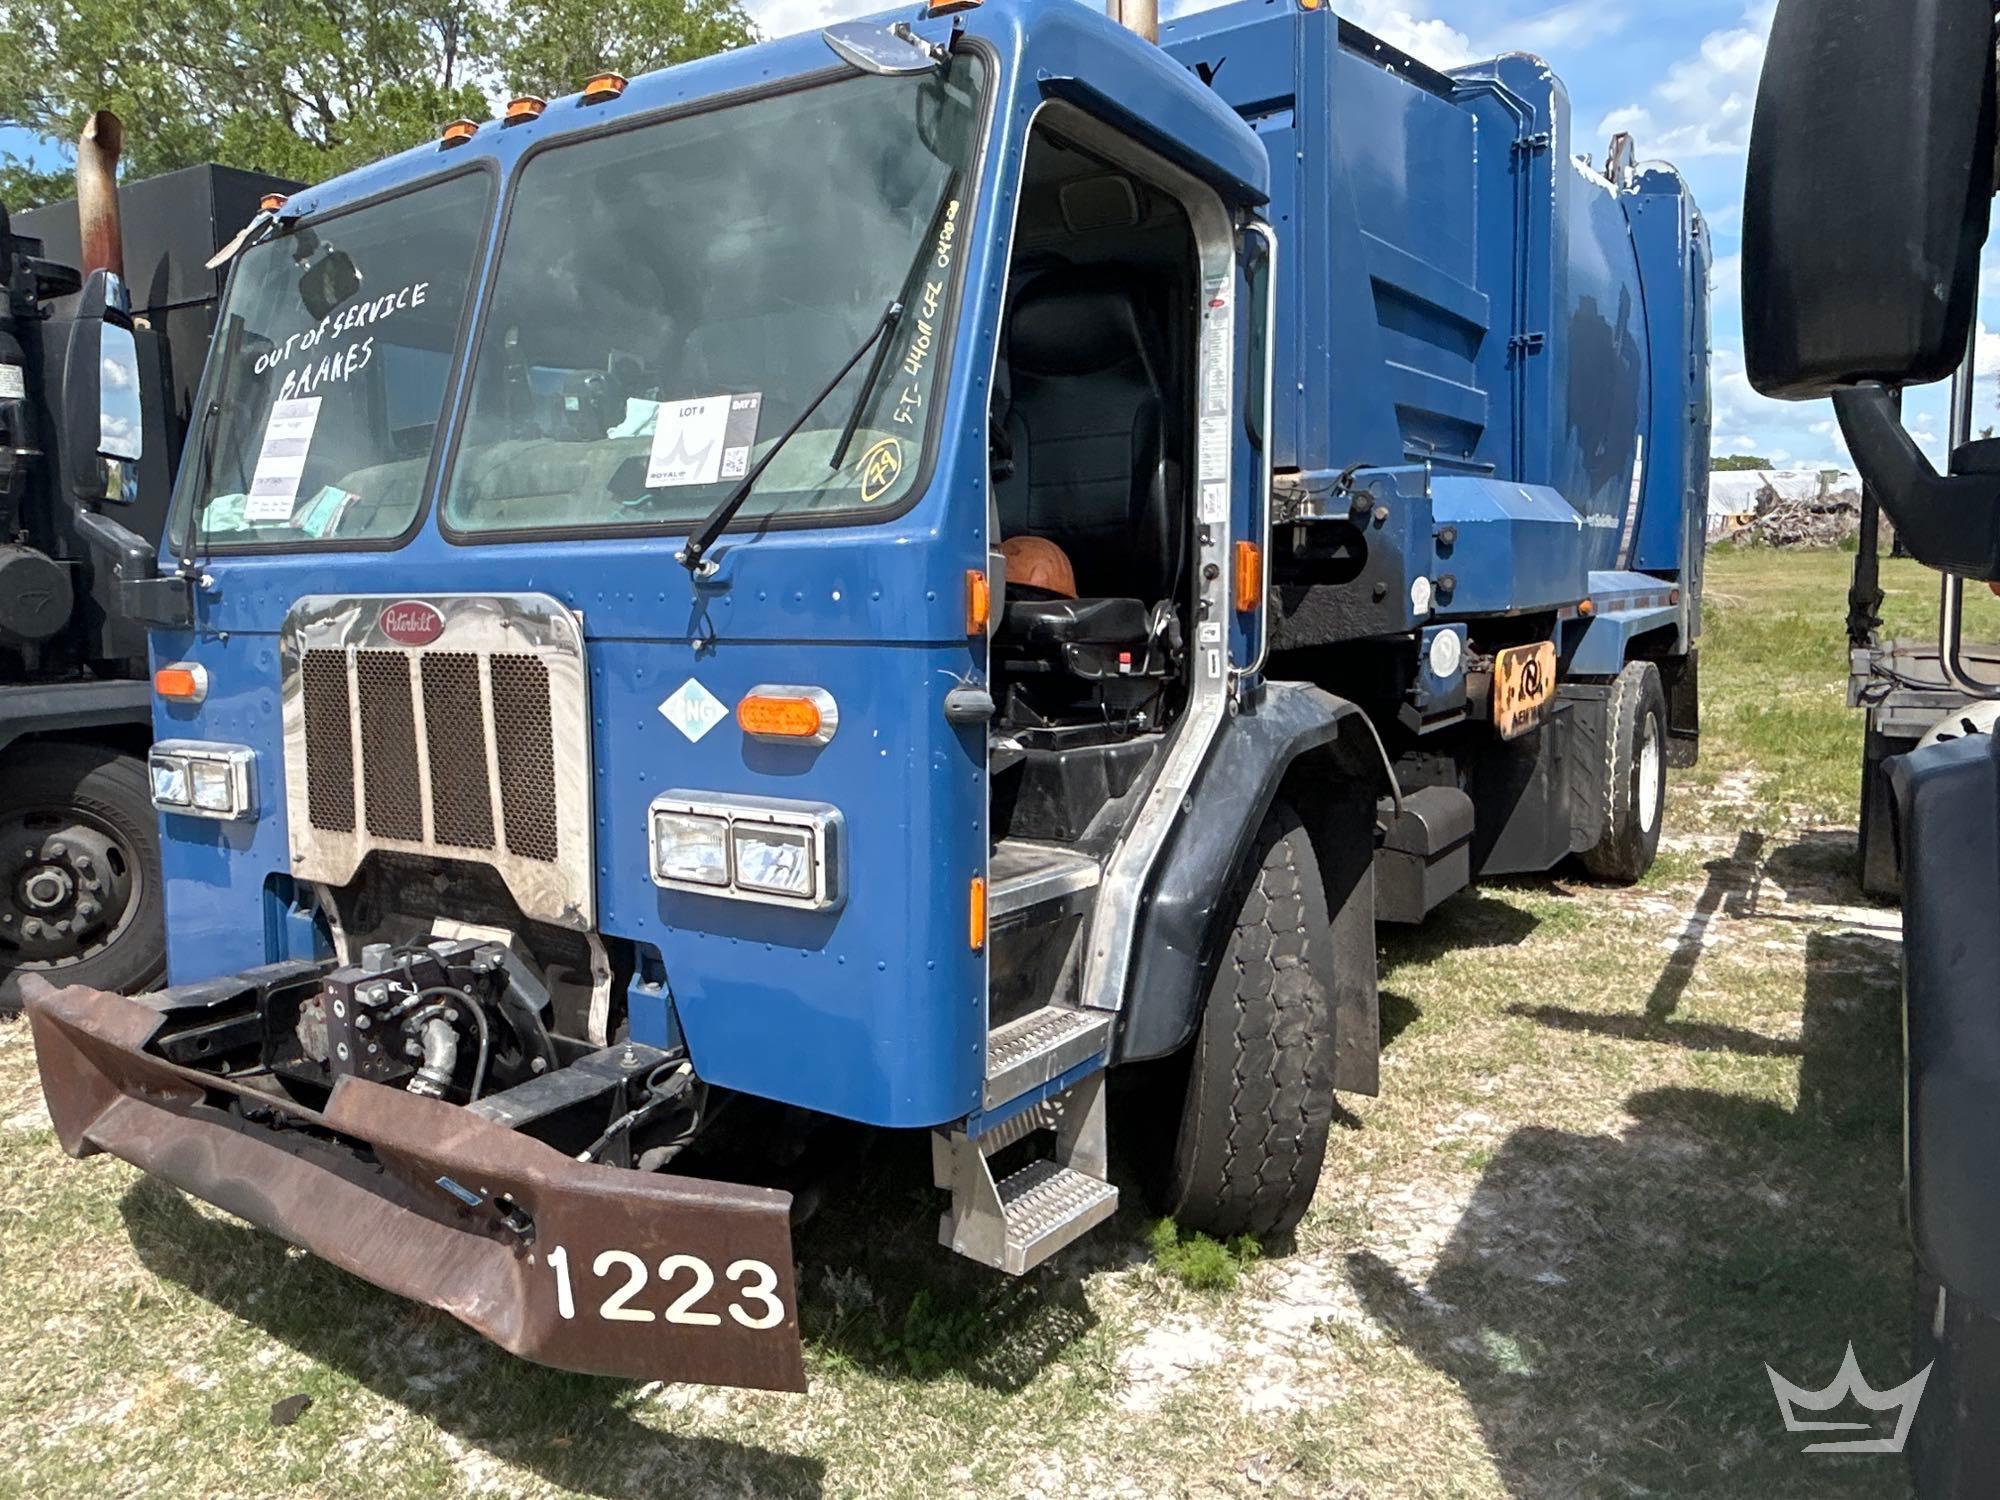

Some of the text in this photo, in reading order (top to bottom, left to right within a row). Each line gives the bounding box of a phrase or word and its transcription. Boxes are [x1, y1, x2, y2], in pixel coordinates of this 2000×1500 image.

[254, 282, 429, 375] OUT OF SERVICE
[278, 336, 374, 401] BRAKES
[679, 406, 698, 418] LOT
[386, 609, 436, 634] Peterbilt
[547, 1245, 785, 1330] 1223
